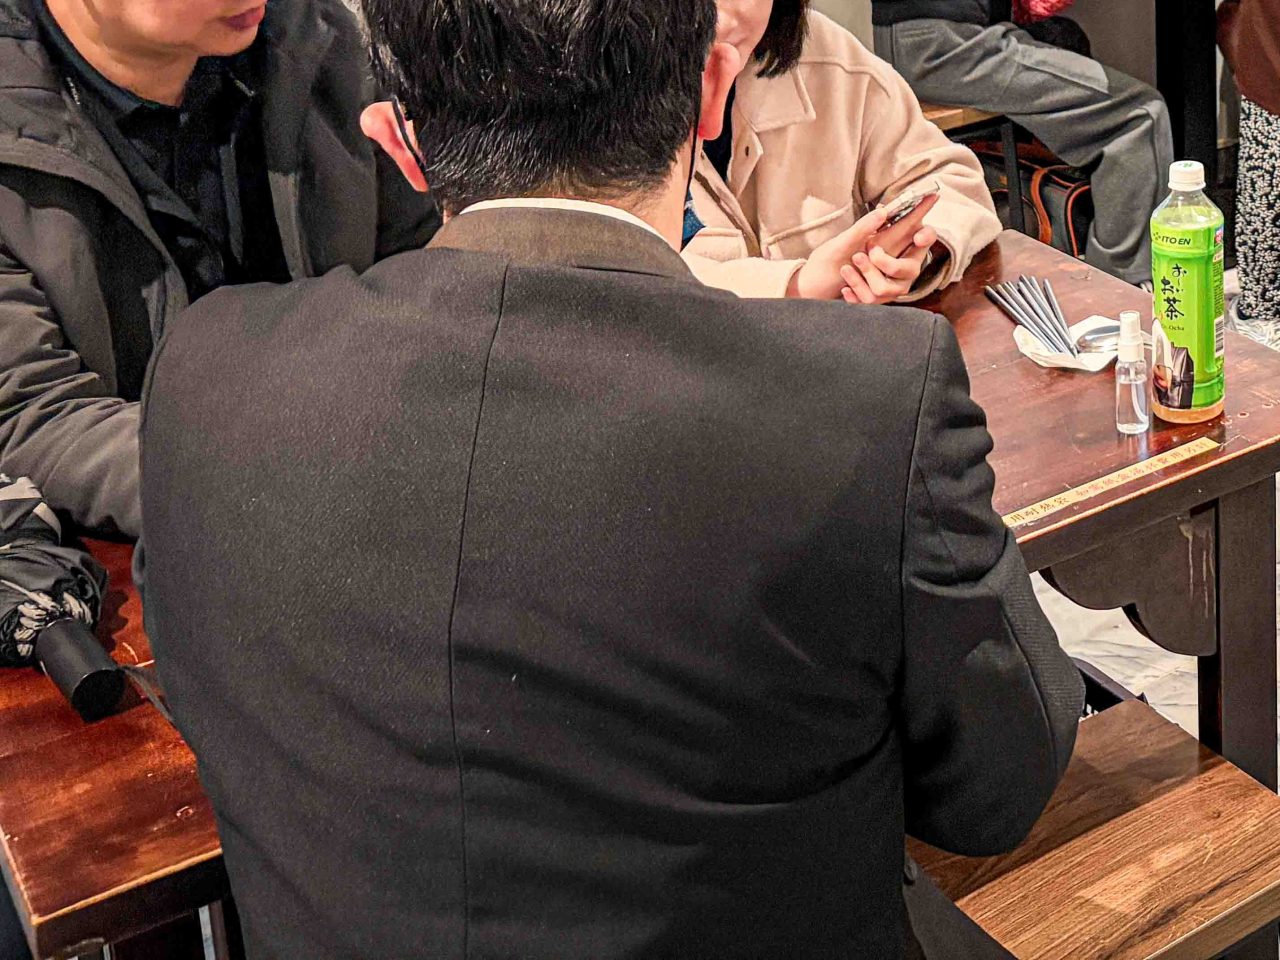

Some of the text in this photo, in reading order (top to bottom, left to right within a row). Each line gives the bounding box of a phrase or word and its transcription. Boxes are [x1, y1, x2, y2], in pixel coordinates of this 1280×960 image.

[1162, 236, 1191, 246] ITO EN
[1161, 276, 1185, 321] お茶
